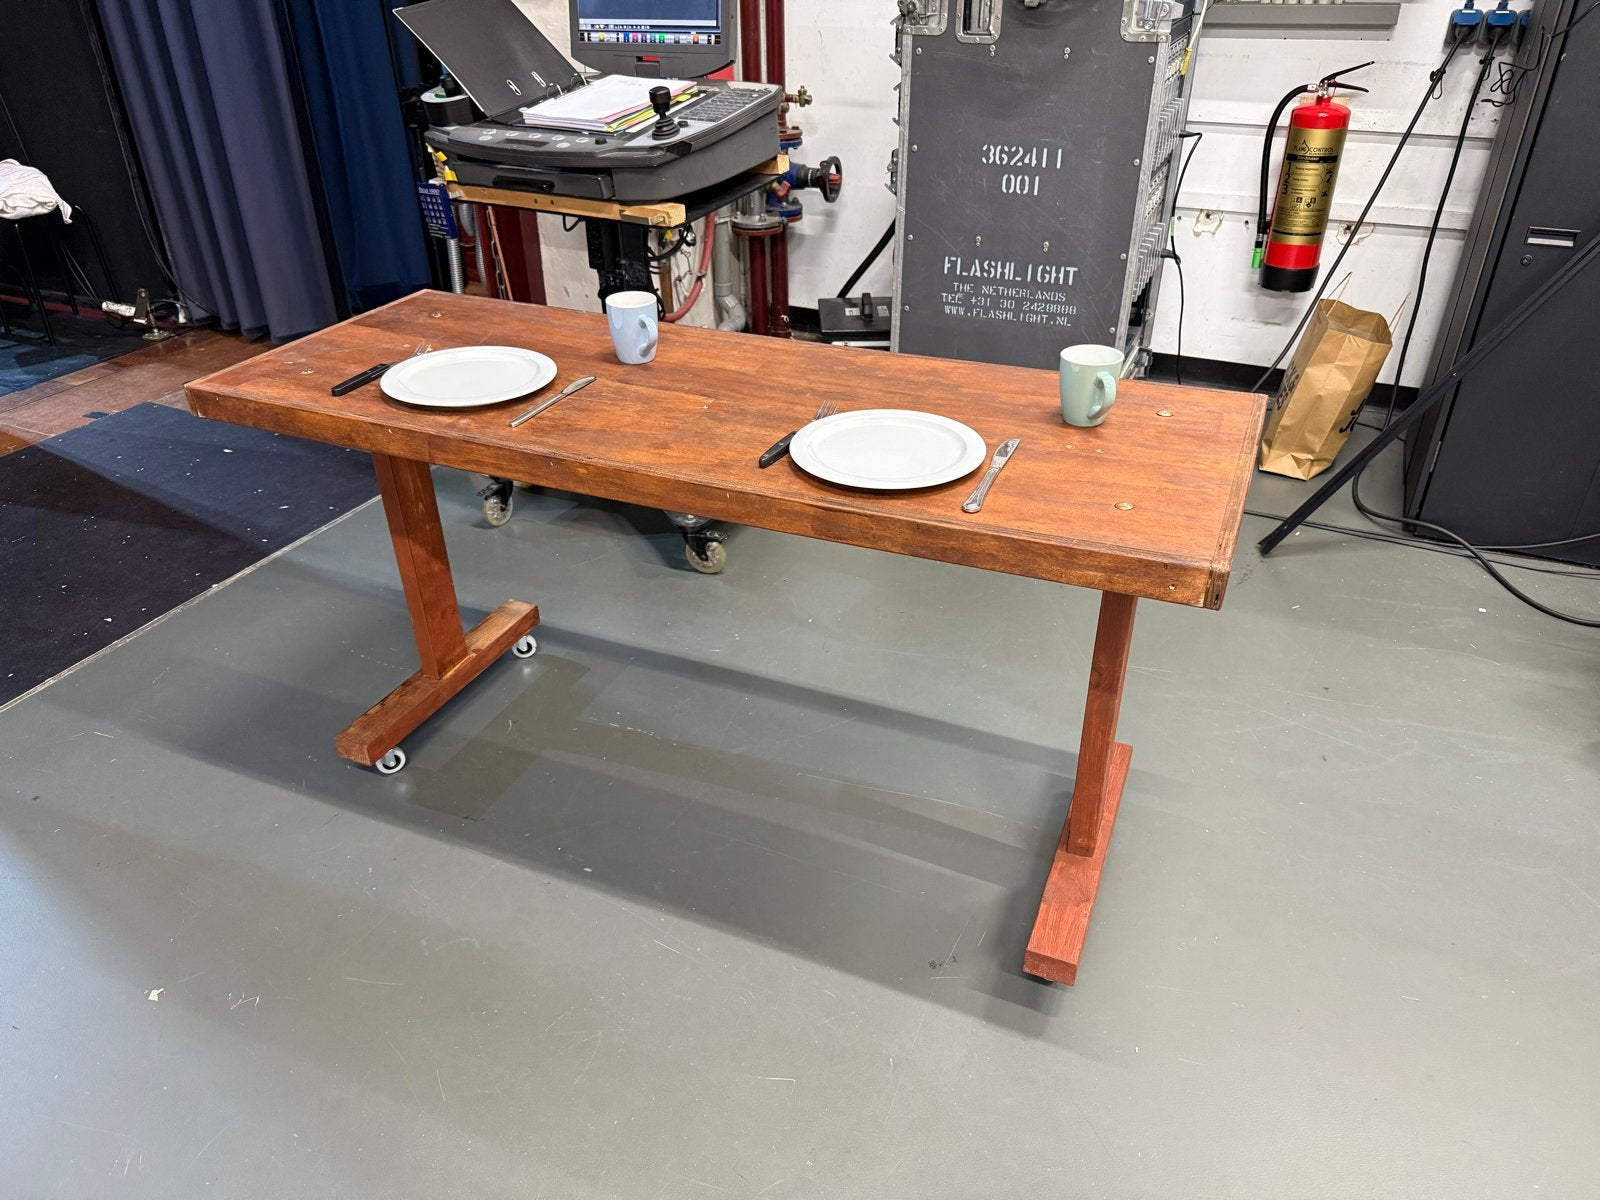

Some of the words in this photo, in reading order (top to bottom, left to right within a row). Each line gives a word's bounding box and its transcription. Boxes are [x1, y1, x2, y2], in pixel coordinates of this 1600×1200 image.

[982, 144, 1062, 169] 362411
[1001, 174, 1039, 196] 001
[1284, 173, 1290, 183] 2
[1282, 184, 1288, 194] 3
[943, 256, 1079, 286] FLASHLIGHT
[953, 282, 974, 293] THE
[981, 285, 1066, 302] NETHERLANDS
[970, 296, 990, 307] +31
[999, 299, 1015, 309] 30
[944, 305, 1072, 327] WWW.FLASHLIGHT.NL
